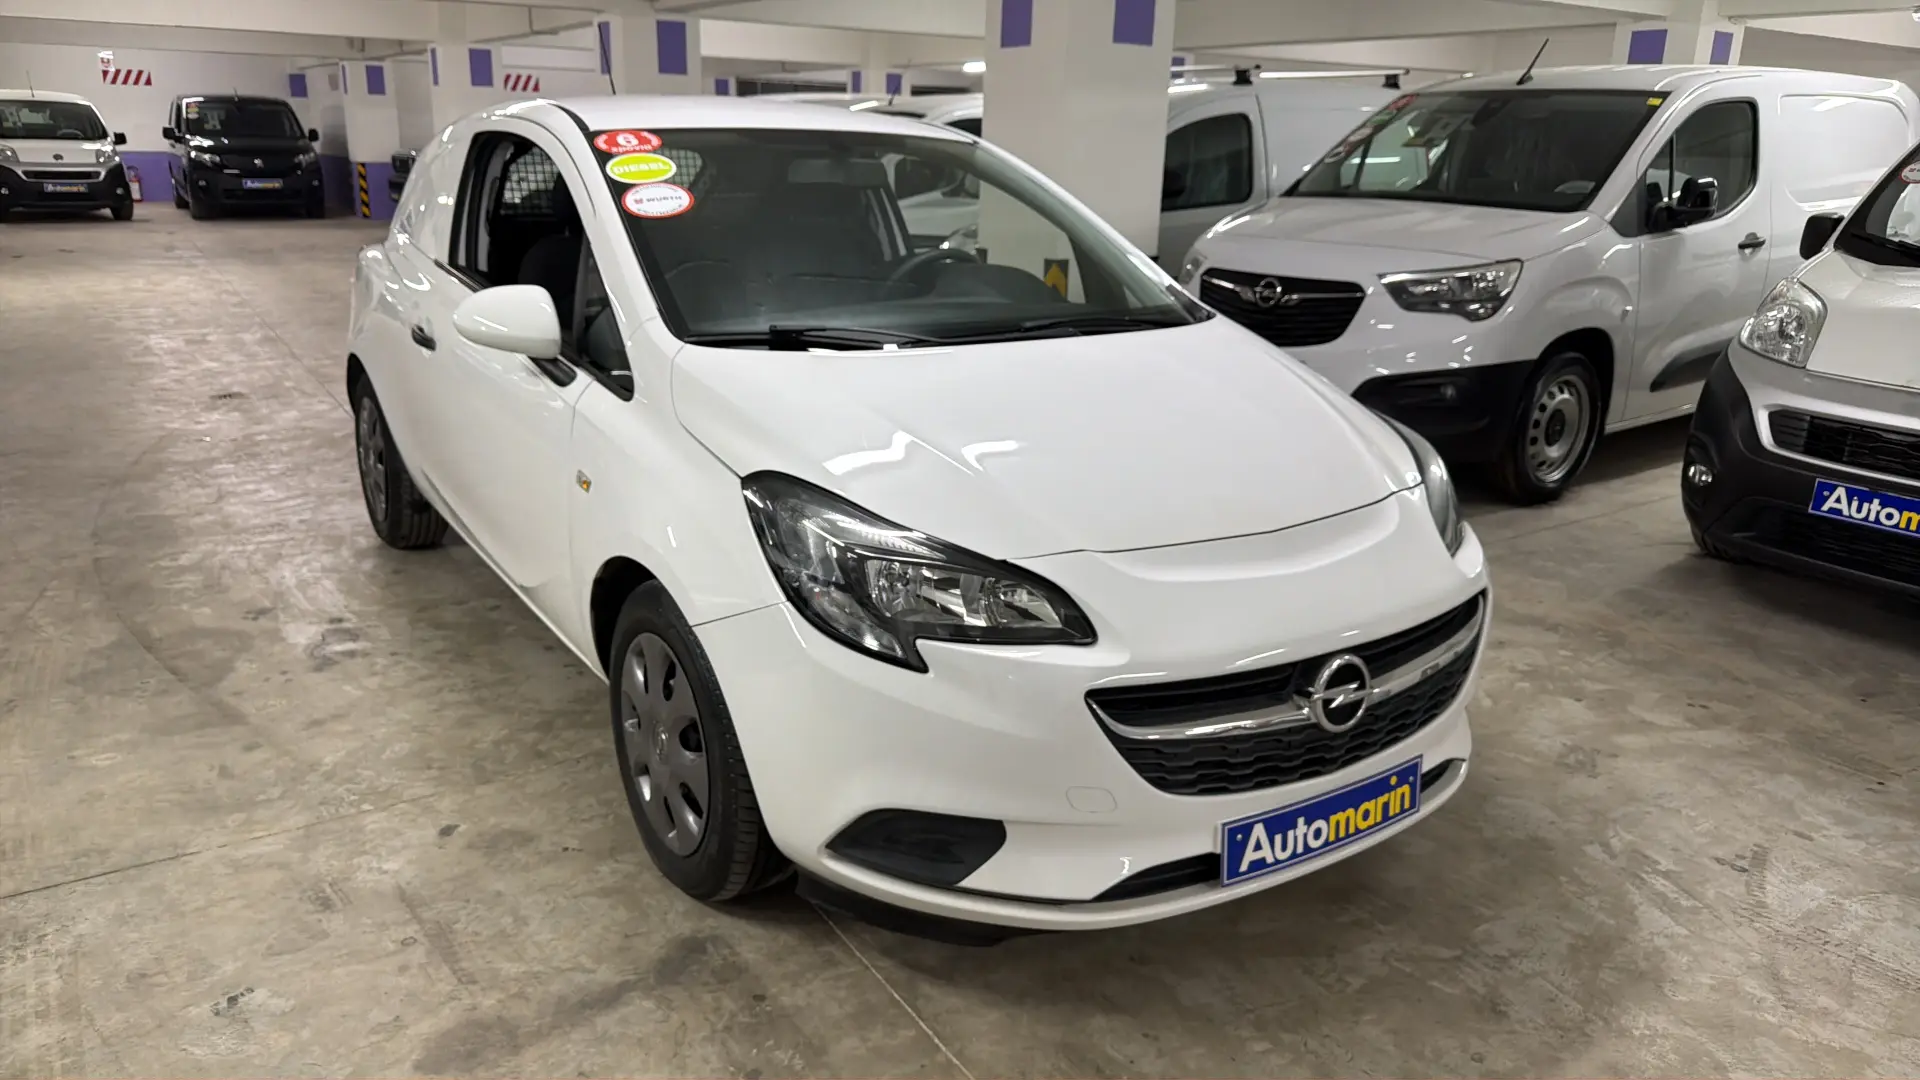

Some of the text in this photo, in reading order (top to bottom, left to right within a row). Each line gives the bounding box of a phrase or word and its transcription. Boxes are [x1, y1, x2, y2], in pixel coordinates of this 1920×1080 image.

[616, 133, 639, 147] 6
[613, 162, 670, 174] DIESEL
[1238, 774, 1411, 873] Automarin
